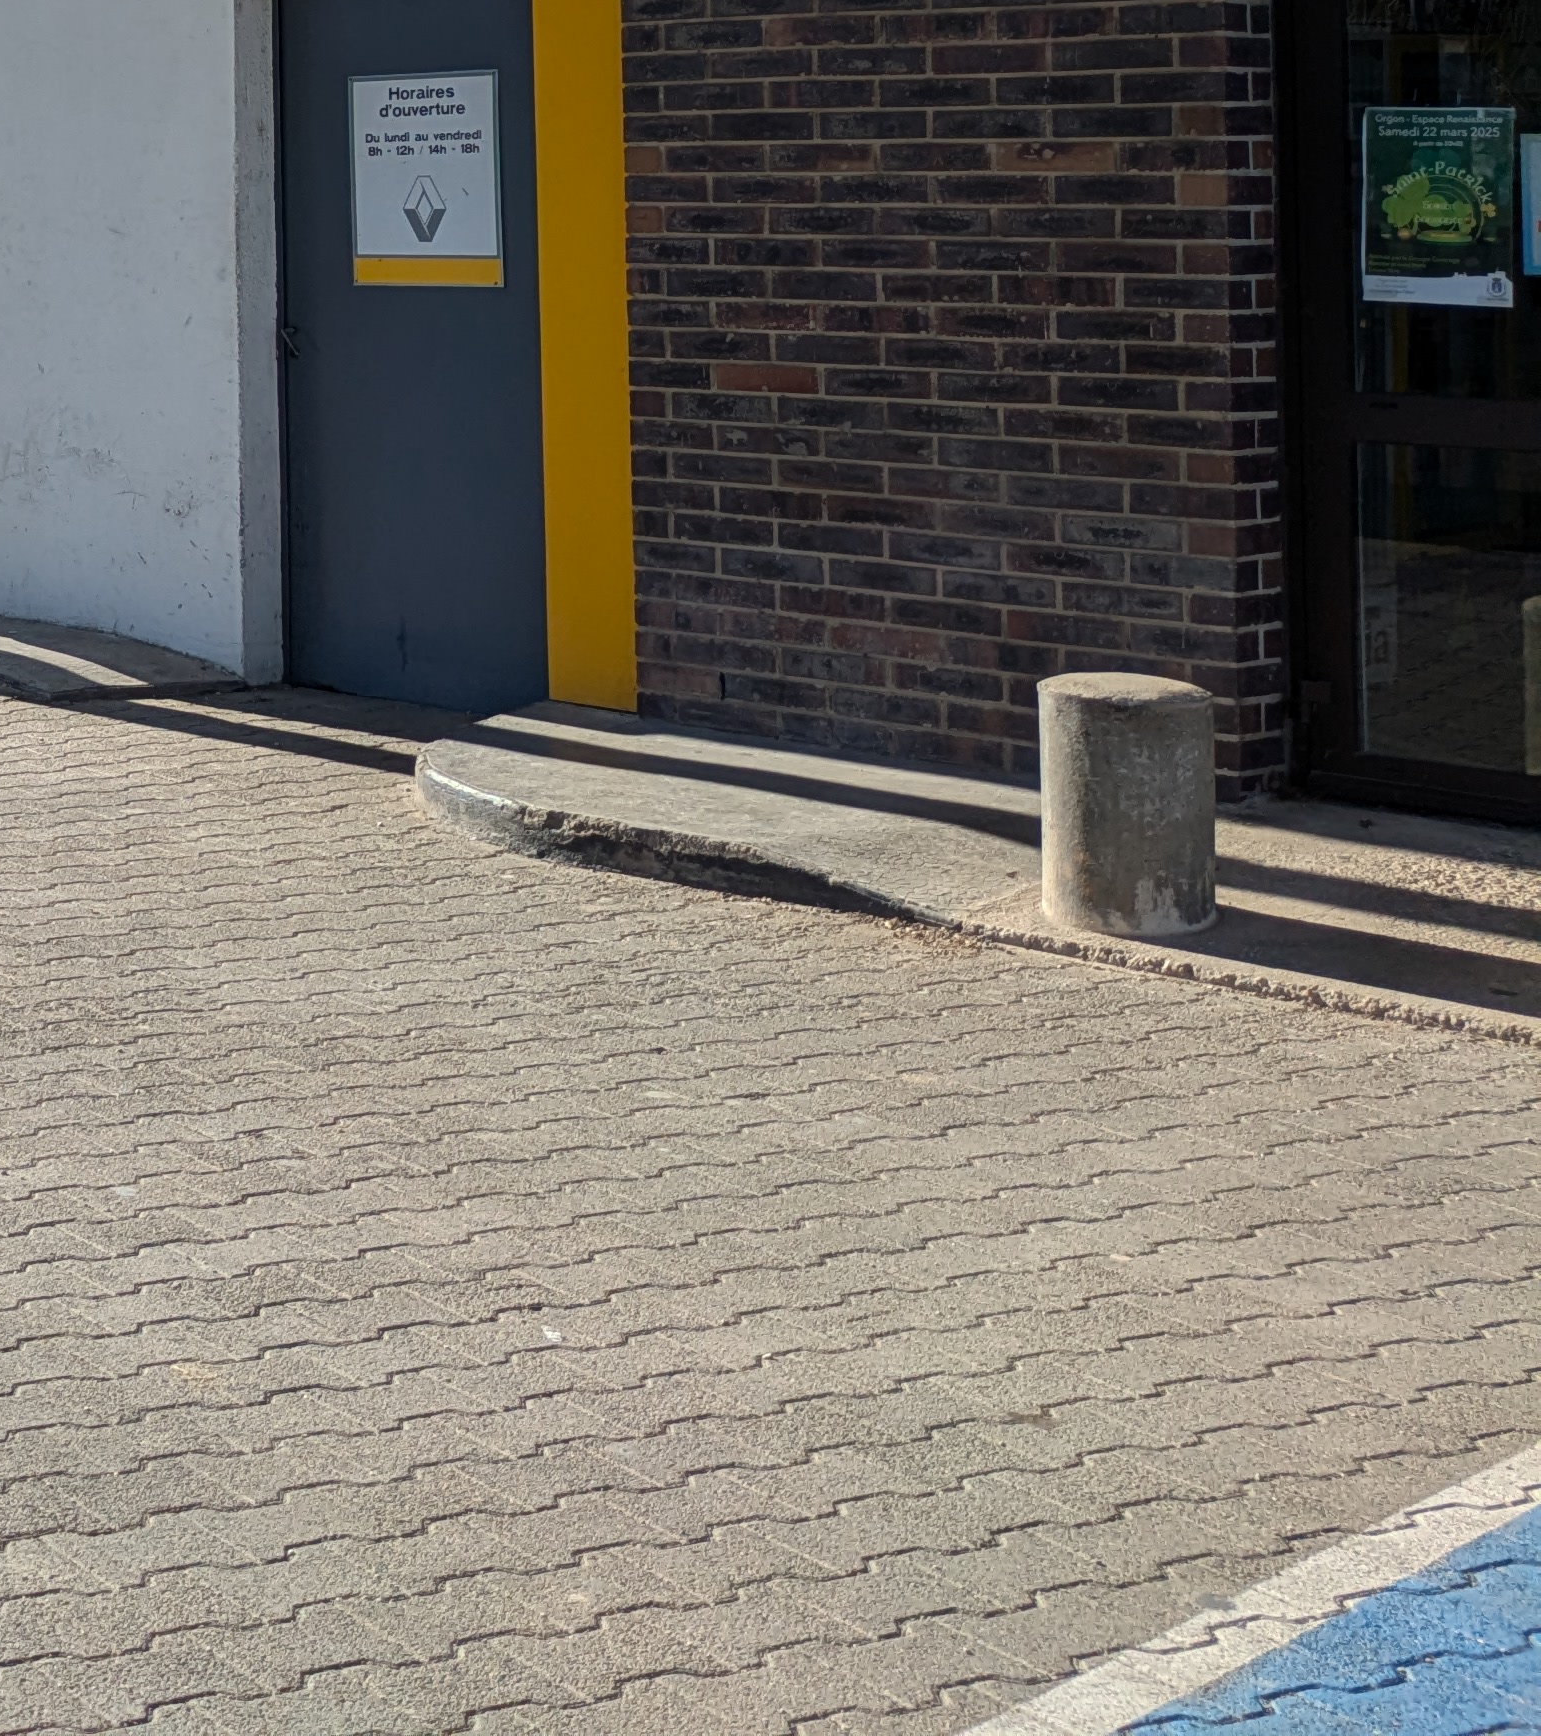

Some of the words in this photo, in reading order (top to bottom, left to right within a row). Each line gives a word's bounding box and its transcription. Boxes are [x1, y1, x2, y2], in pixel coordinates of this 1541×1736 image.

[388, 85, 455, 101] Horaires
[379, 102, 466, 118] d'ouverture
[1375, 114, 1405, 125] Orgon
[1412, 115, 1444, 125] Espace
[1446, 114, 1504, 124] Renaissance
[365, 132, 381, 144] Du
[384, 131, 410, 143] lundi
[414, 132, 428, 142] au
[433, 130, 482, 141] vendredi
[1378, 126, 1420, 137] Samedi
[1422, 127, 1437, 137] 22
[1440, 128, 1468, 137] mars
[1470, 126, 1501, 138] 2025
[368, 146, 383, 156] 8h
[395, 145, 415, 156] 12h
[428, 144, 447, 155] 14h
[460, 143, 480, 154] 18h
